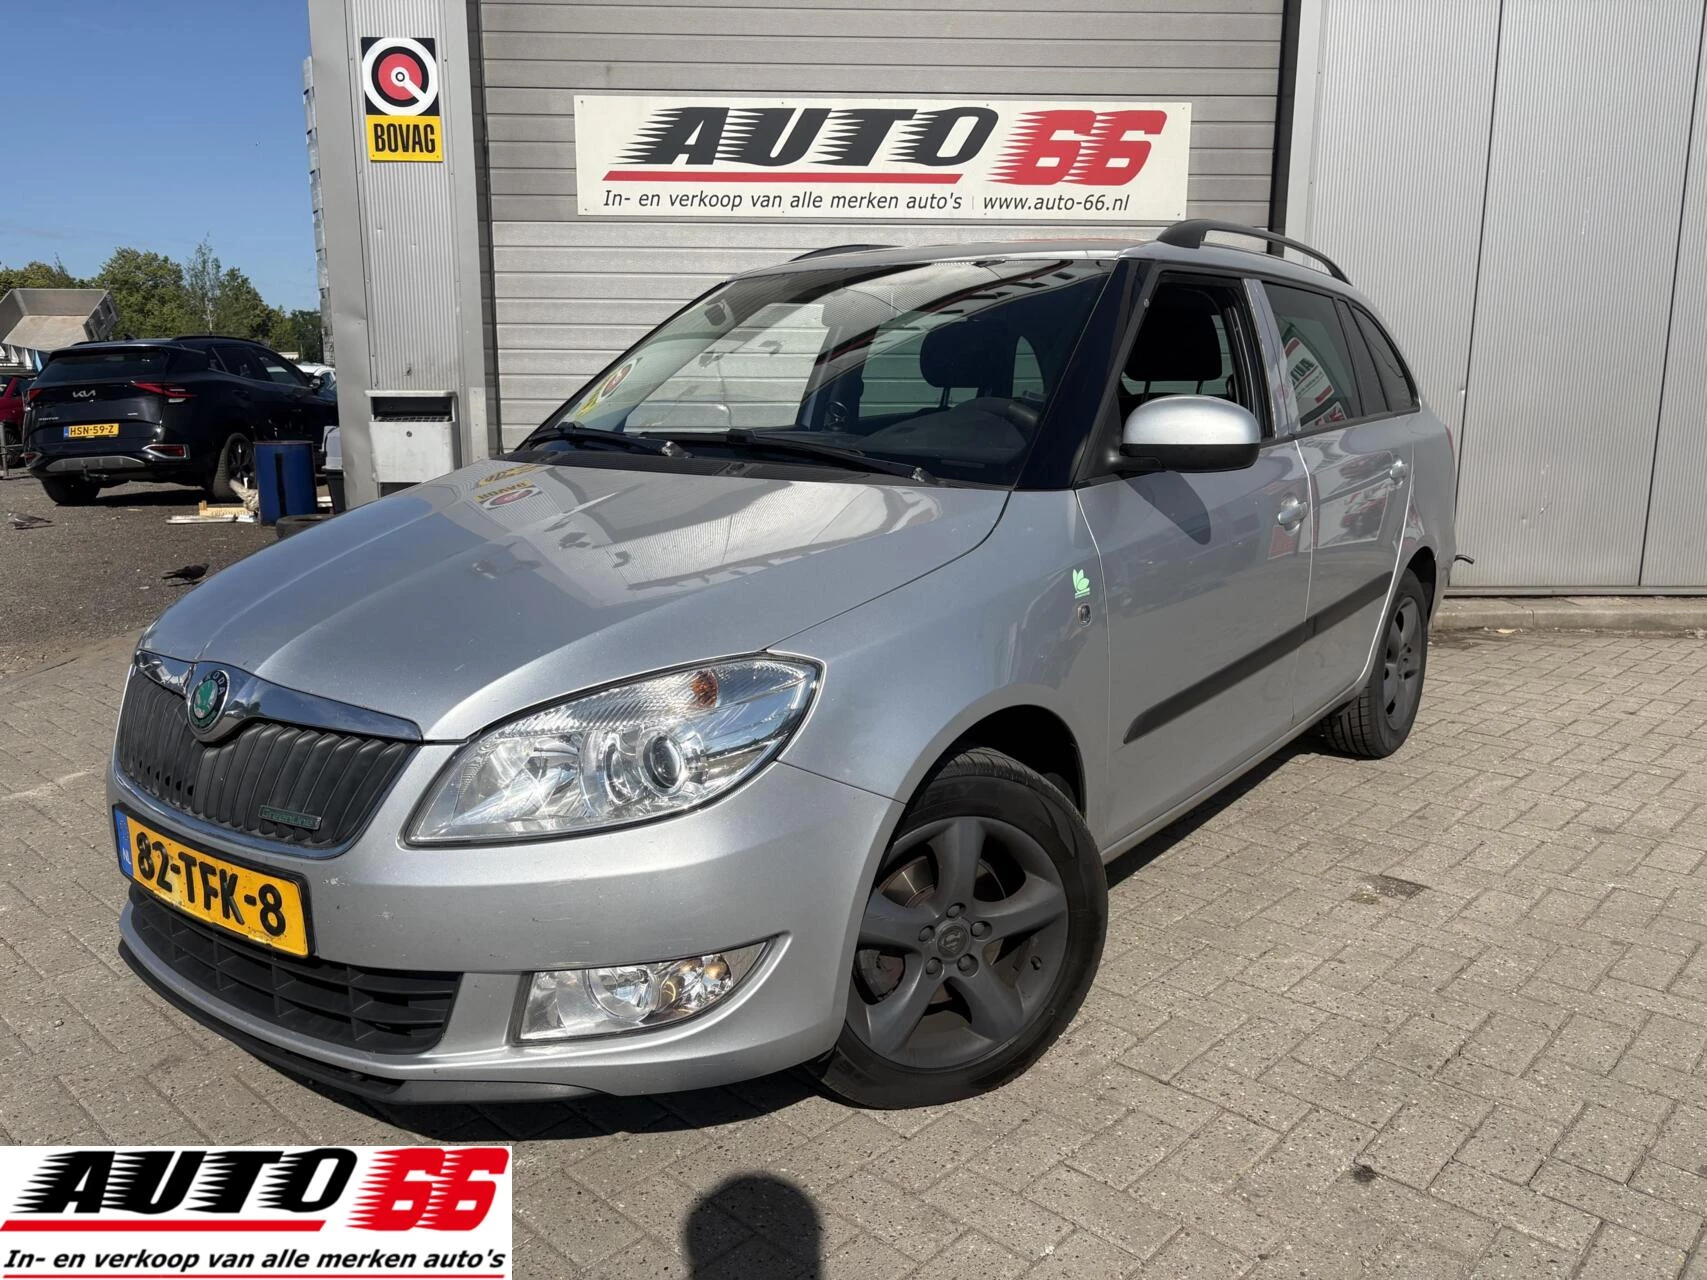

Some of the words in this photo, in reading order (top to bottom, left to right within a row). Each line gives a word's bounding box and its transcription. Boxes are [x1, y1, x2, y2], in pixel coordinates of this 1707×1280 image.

[373, 123, 436, 153] BOVAG
[609, 106, 999, 167] AUTO
[985, 109, 1168, 186] 66
[603, 191, 631, 207] In-
[638, 193, 661, 207] en
[670, 191, 743, 211] verkoop
[751, 194, 783, 208] van
[790, 191, 823, 209] alle
[830, 192, 899, 209] merken
[906, 192, 962, 210] auto's
[983, 193, 1130, 211] www.auto-66.nl
[70, 424, 114, 436] HSN-59-Z
[136, 831, 287, 937] 82-TFK-8
